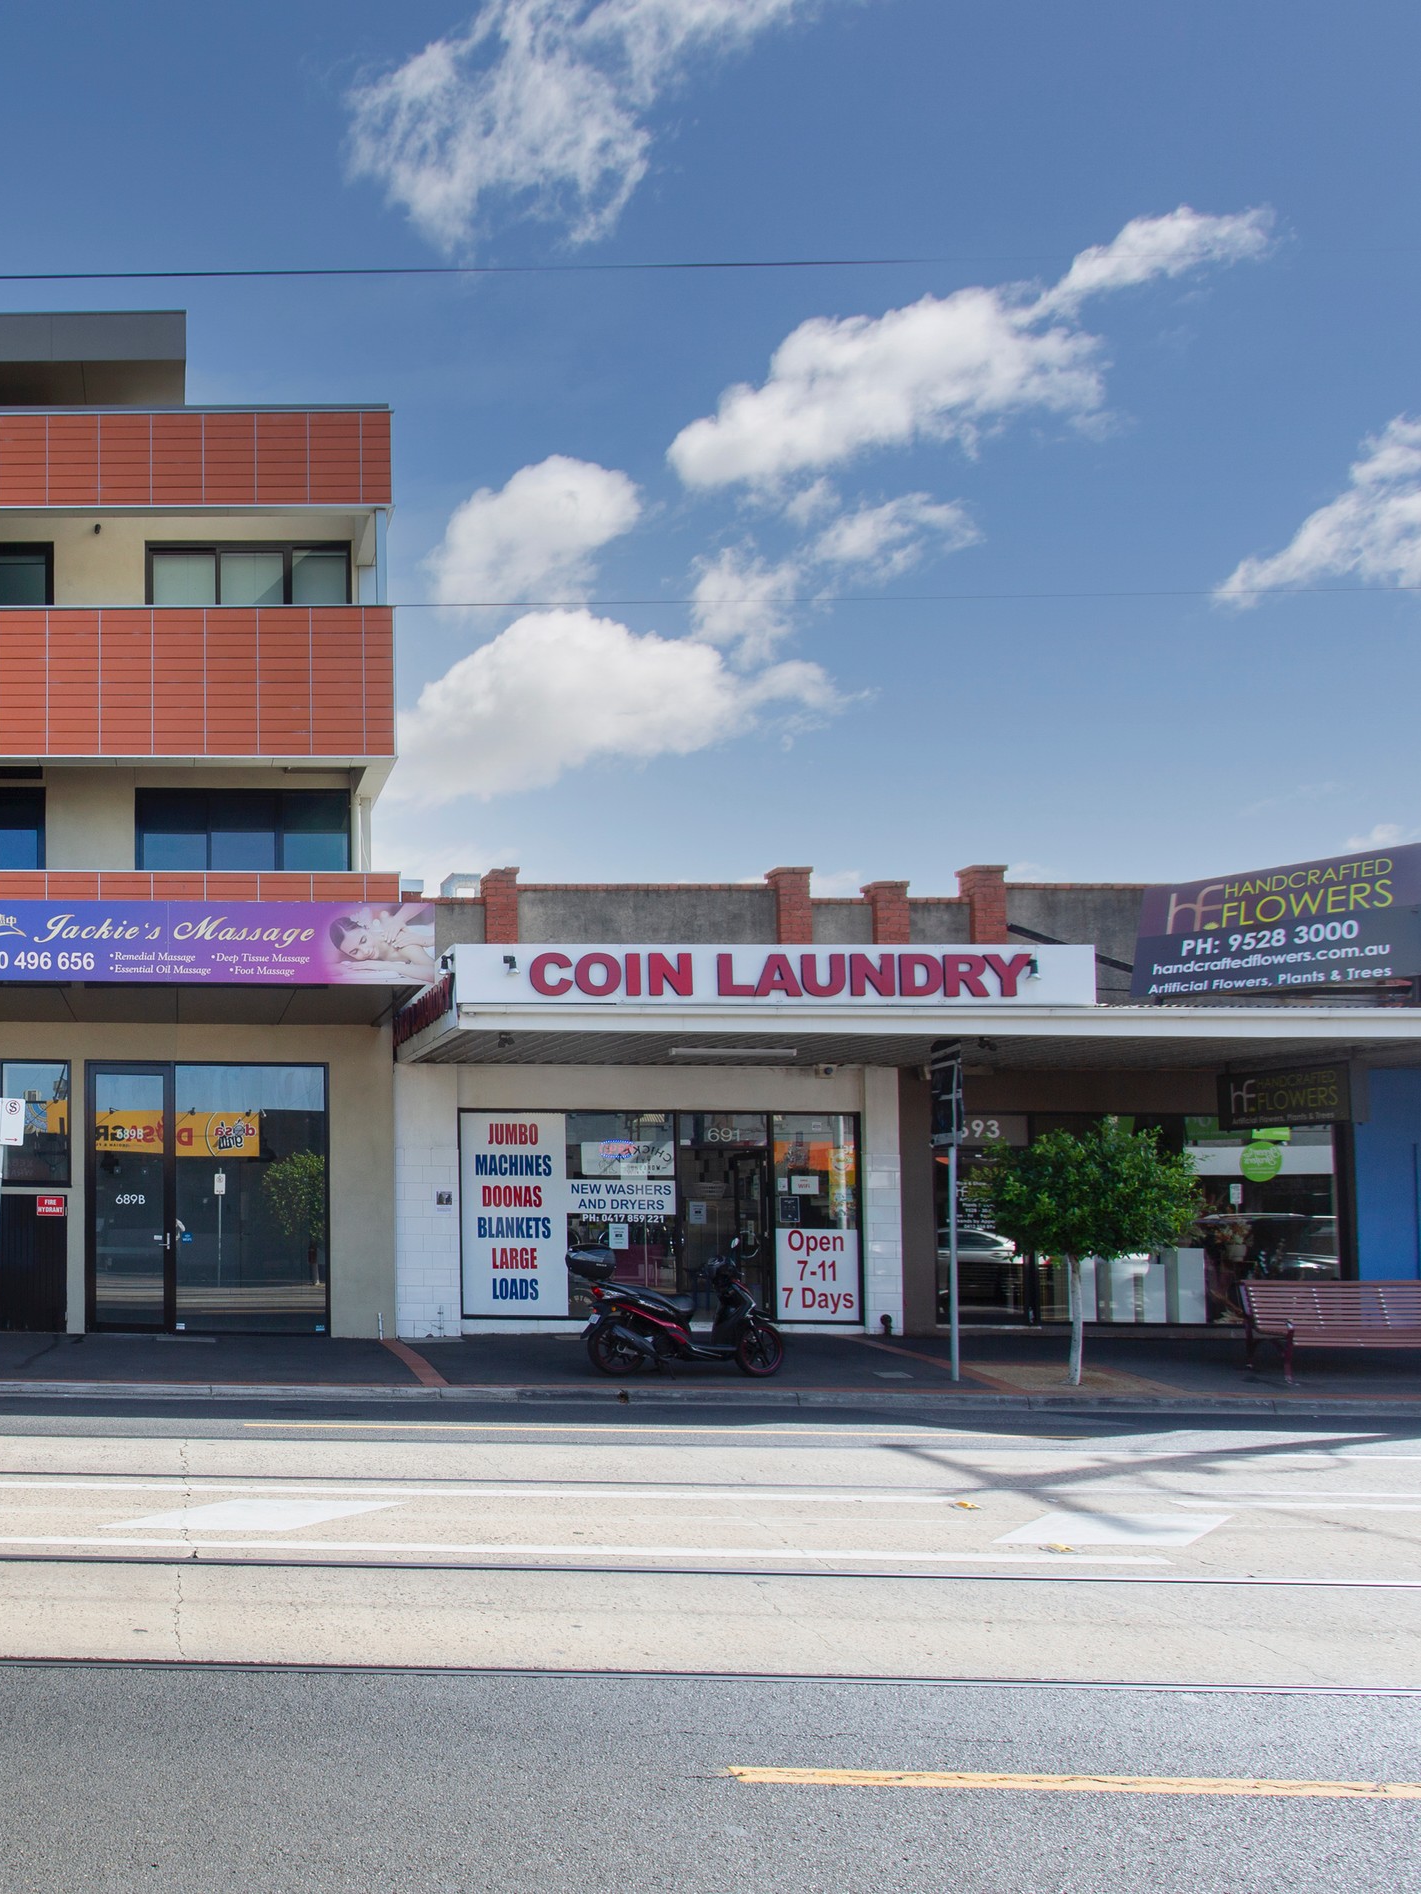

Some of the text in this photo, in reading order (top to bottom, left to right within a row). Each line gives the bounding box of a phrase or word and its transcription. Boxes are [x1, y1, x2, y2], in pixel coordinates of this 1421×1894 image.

[1224, 858, 1392, 899] HANDCRAFTED
[1222, 879, 1393, 928] FLOWERS
[173, 916, 315, 948] Massage
[1181, 920, 1359, 957] PH: 9528 3000
[14, 952, 52, 970] 496
[57, 952, 95, 970] 656
[115, 952, 196, 962] Remedial Massage
[216, 953, 310, 964] Deep Tissue Massage
[1152, 943, 1391, 976] handcraftedflowers.com.au
[115, 965, 212, 976] Essential Oil Massage
[235, 966, 295, 976] Foot Massage
[529, 952, 1033, 997] COIN LAUNDRY
[1148, 966, 1392, 995] Artificial Flowers, Plants & Trees
[1257, 1070, 1336, 1087] HANDCRAFTED
[1257, 1086, 1338, 1111] FLOWERS
[488, 1123, 539, 1145] JUMBO
[707, 1128, 740, 1142] 691
[475, 1154, 552, 1176] MACHINES
[115, 1194, 146, 1205] 689B
[482, 1185, 542, 1208] DOONAS
[571, 1183, 672, 1196] NEW WASHERS
[578, 1198, 665, 1210] AND DRYERS
[477, 1217, 551, 1239] BLANKETS
[582, 1214, 664, 1223] PH: 0417 859 221
[788, 1230, 844, 1256] Open
[492, 1248, 537, 1270] LARGE
[797, 1260, 836, 1281] 7-11
[492, 1278, 539, 1300] LOADS
[782, 1287, 854, 1314] 7 Days
